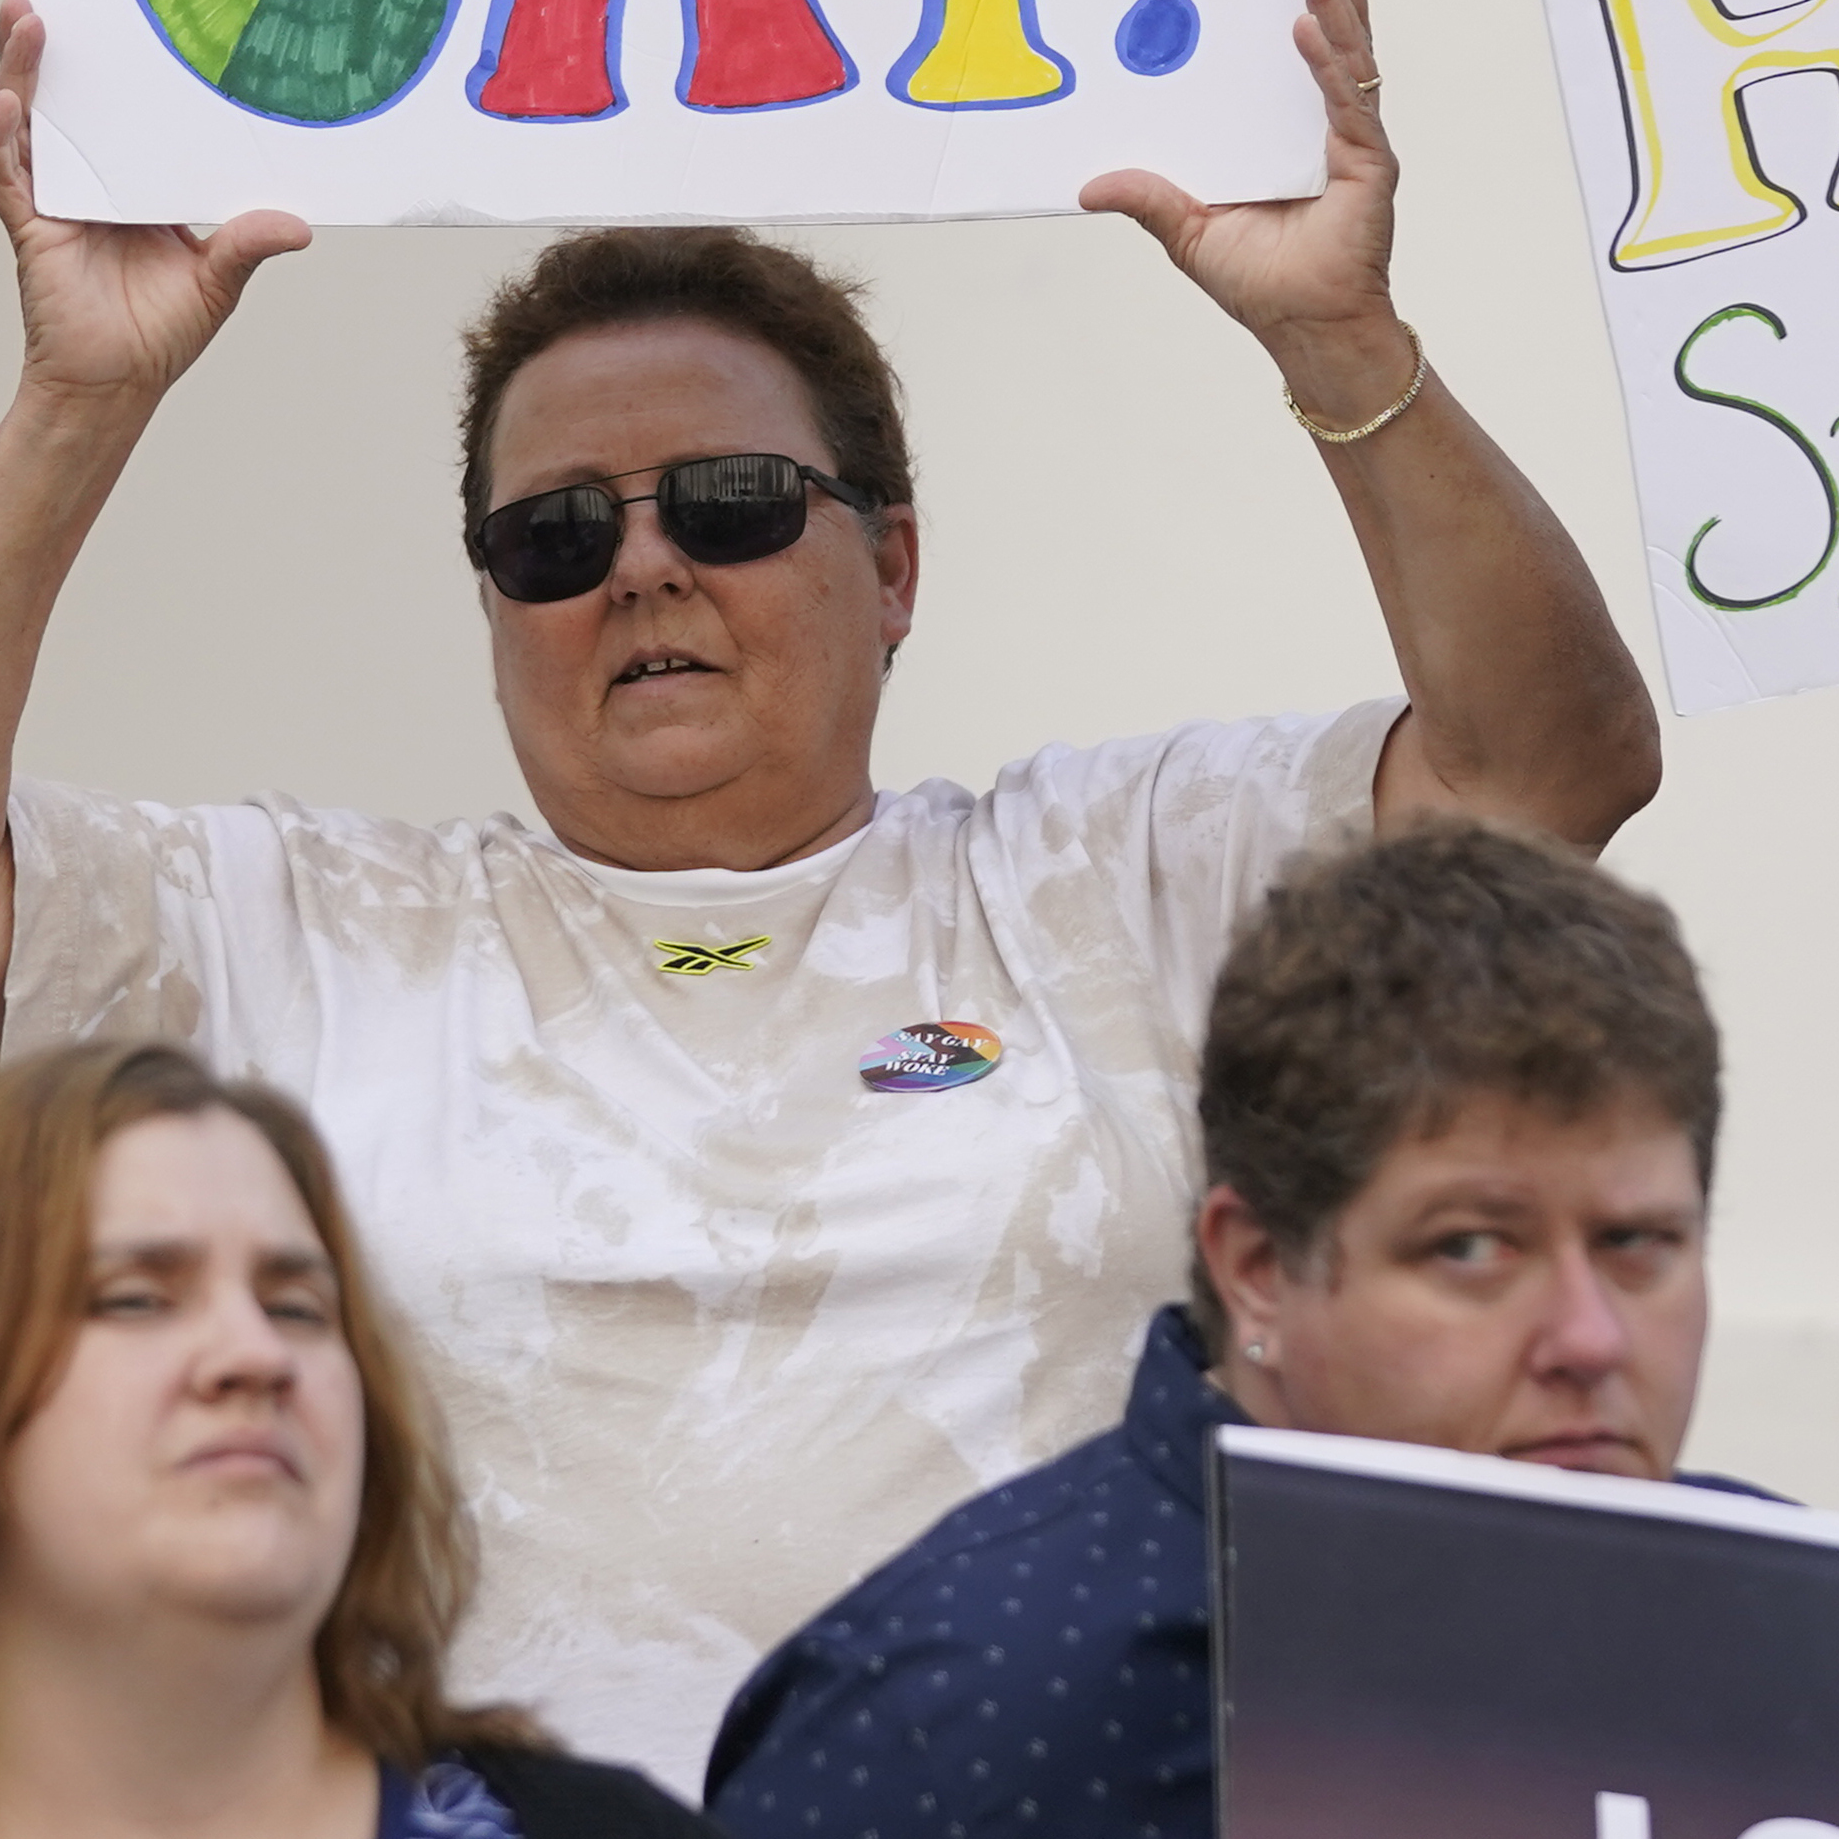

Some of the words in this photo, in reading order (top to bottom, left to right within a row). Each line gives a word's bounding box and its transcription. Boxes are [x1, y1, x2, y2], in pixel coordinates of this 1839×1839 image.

[896, 1031, 940, 1043] SAY
[942, 1035, 990, 1048] GAY
[898, 1050, 956, 1064] STAY
[885, 1061, 950, 1076] WOKE
